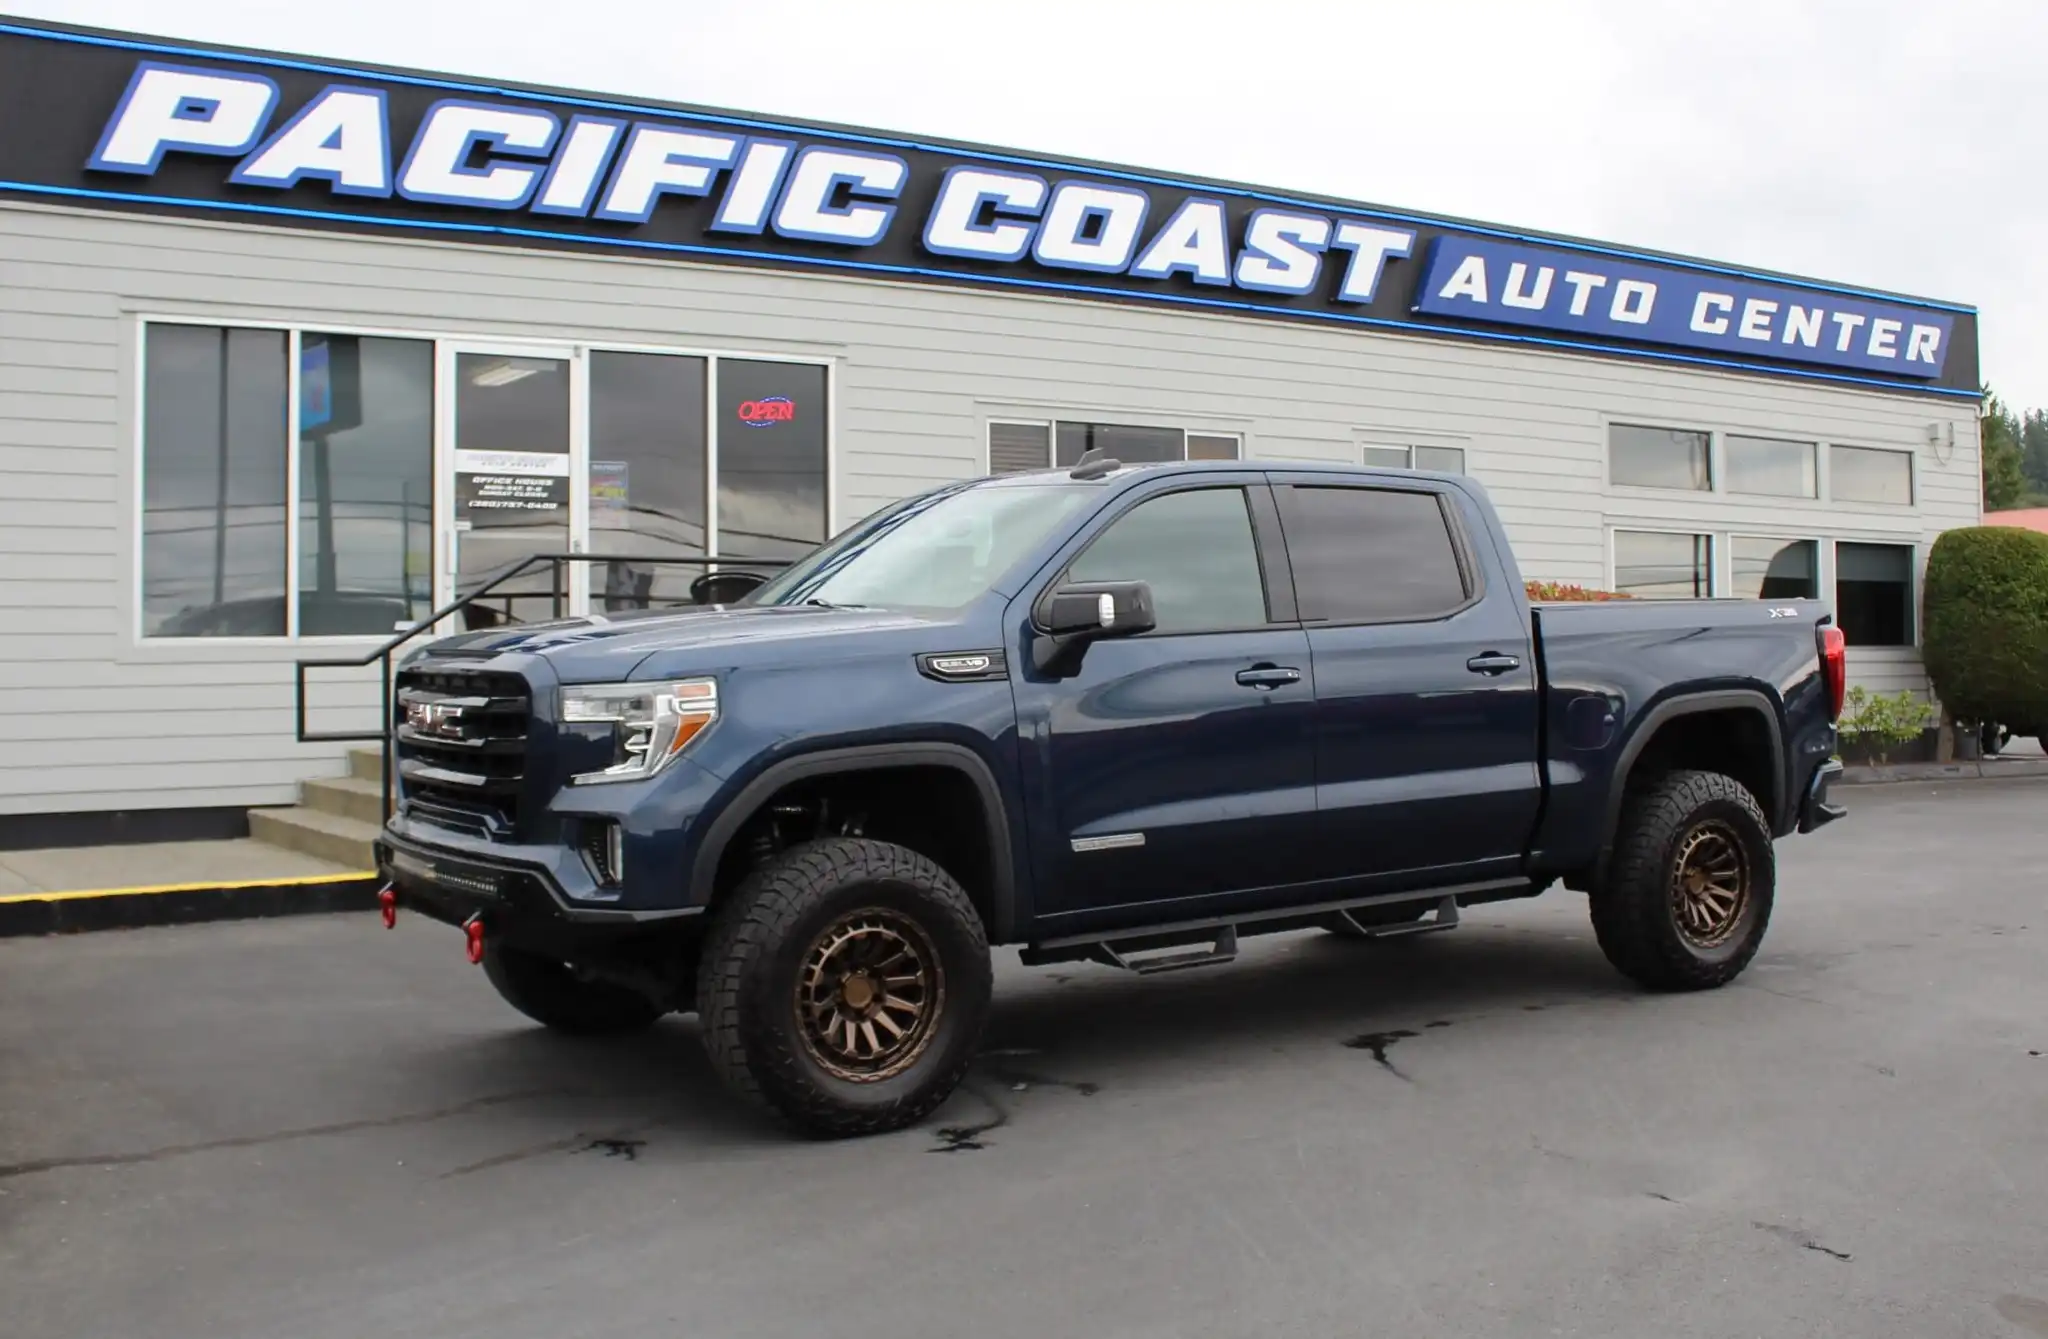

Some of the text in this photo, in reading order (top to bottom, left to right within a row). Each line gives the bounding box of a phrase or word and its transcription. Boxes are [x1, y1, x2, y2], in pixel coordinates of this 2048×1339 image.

[87, 60, 1417, 303] PACIFIC COAST
[1439, 256, 1942, 364] AUTO CENTER
[738, 400, 796, 420] OPEN
